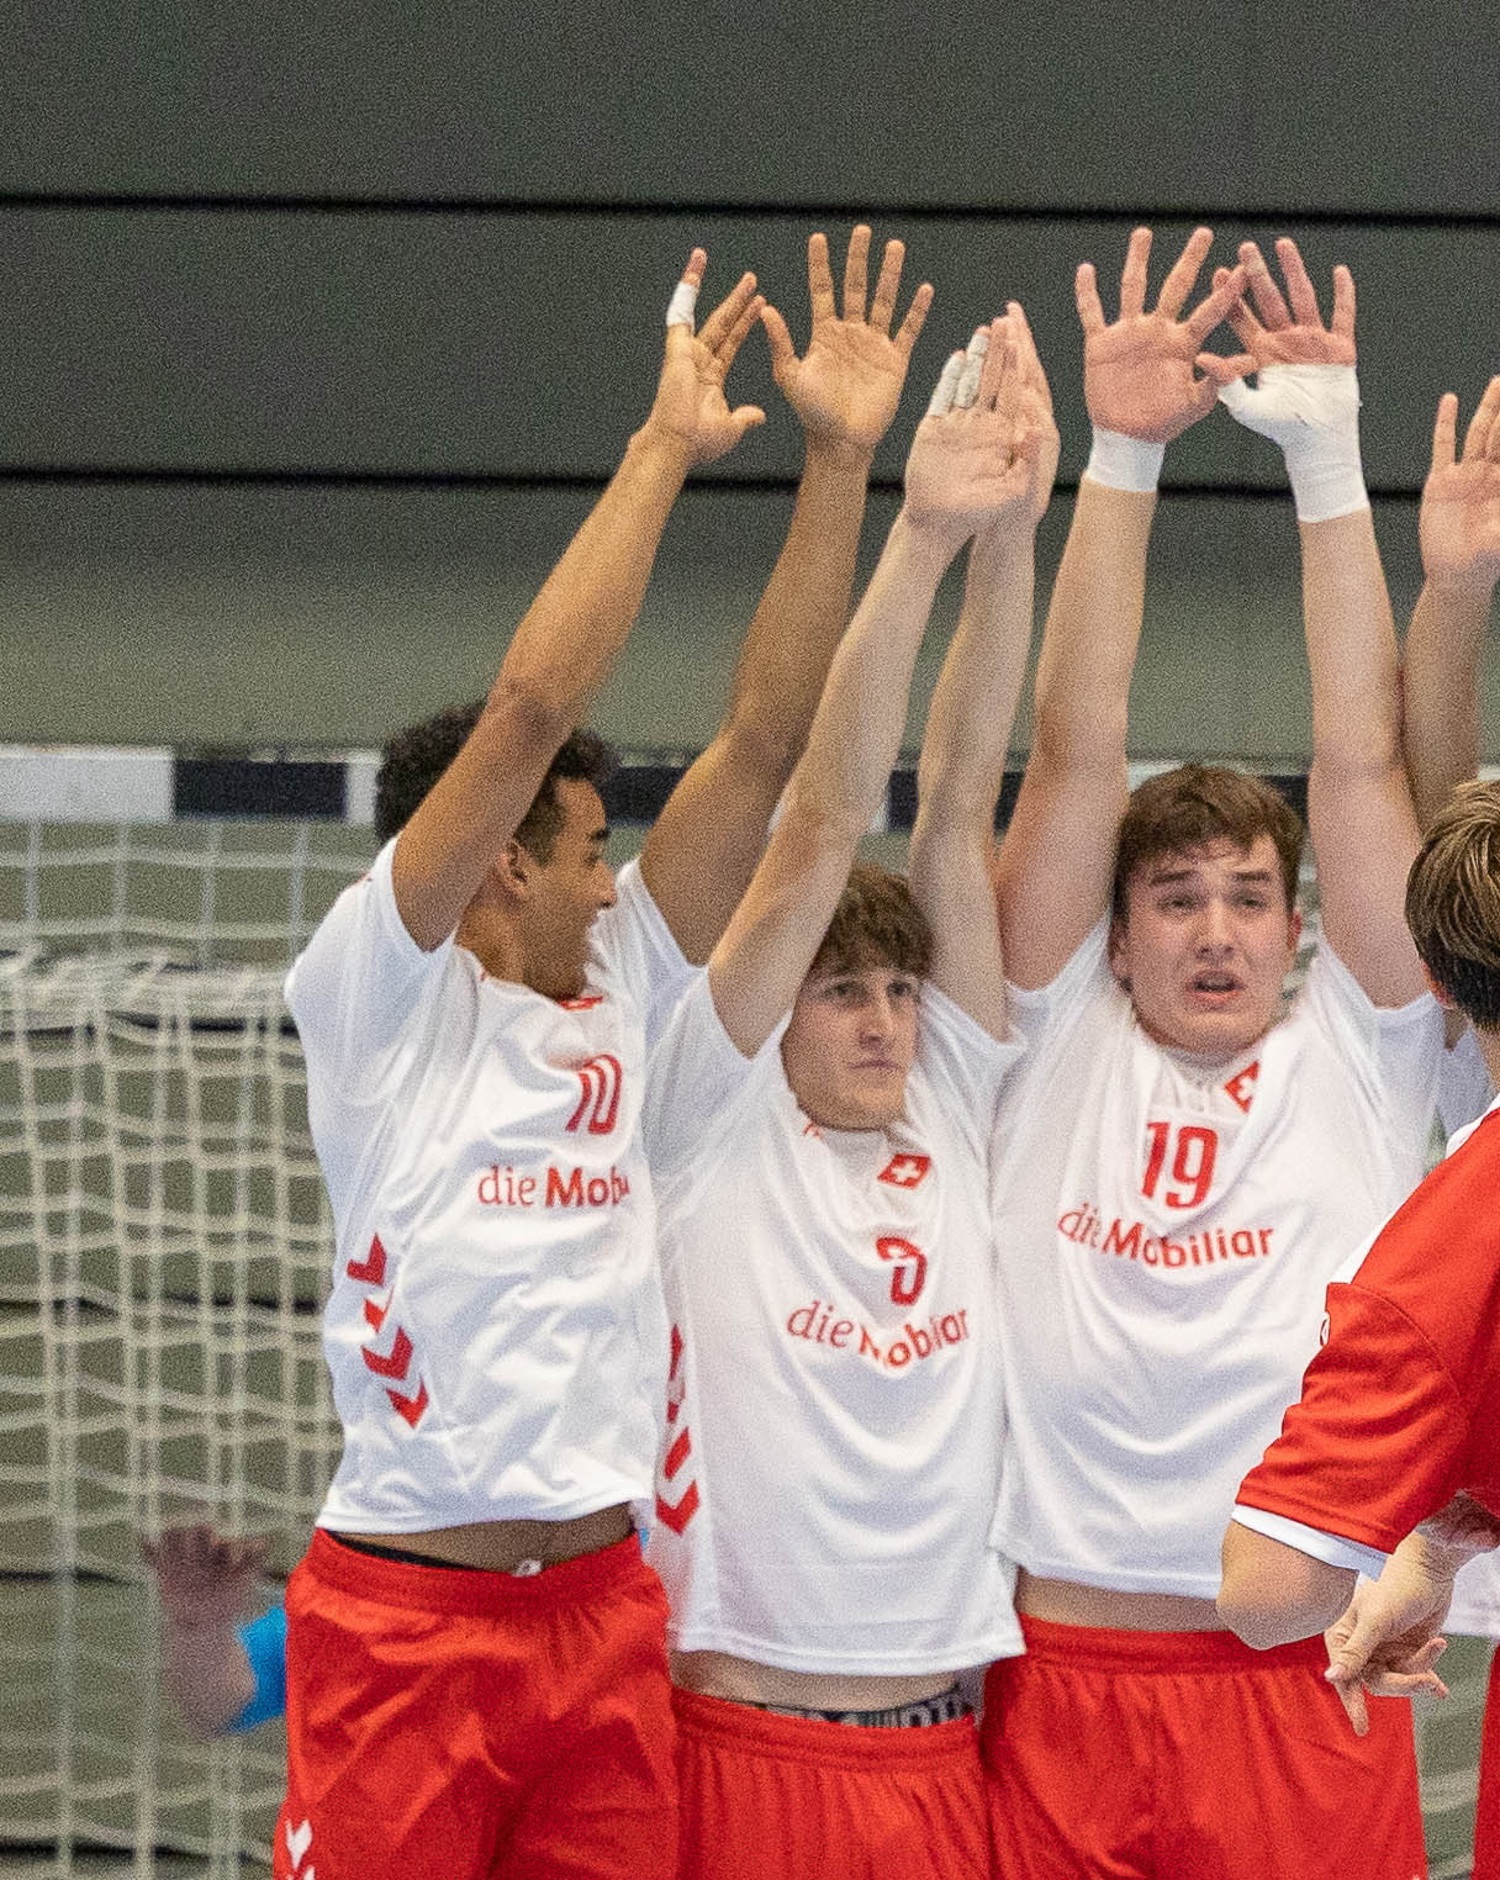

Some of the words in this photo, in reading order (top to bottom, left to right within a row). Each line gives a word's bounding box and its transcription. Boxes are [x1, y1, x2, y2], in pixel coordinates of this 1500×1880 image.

[565, 1054, 622, 1134] 10
[478, 1162, 536, 1206] die
[1142, 1122, 1218, 1210] 19
[787, 1300, 854, 1348] die
